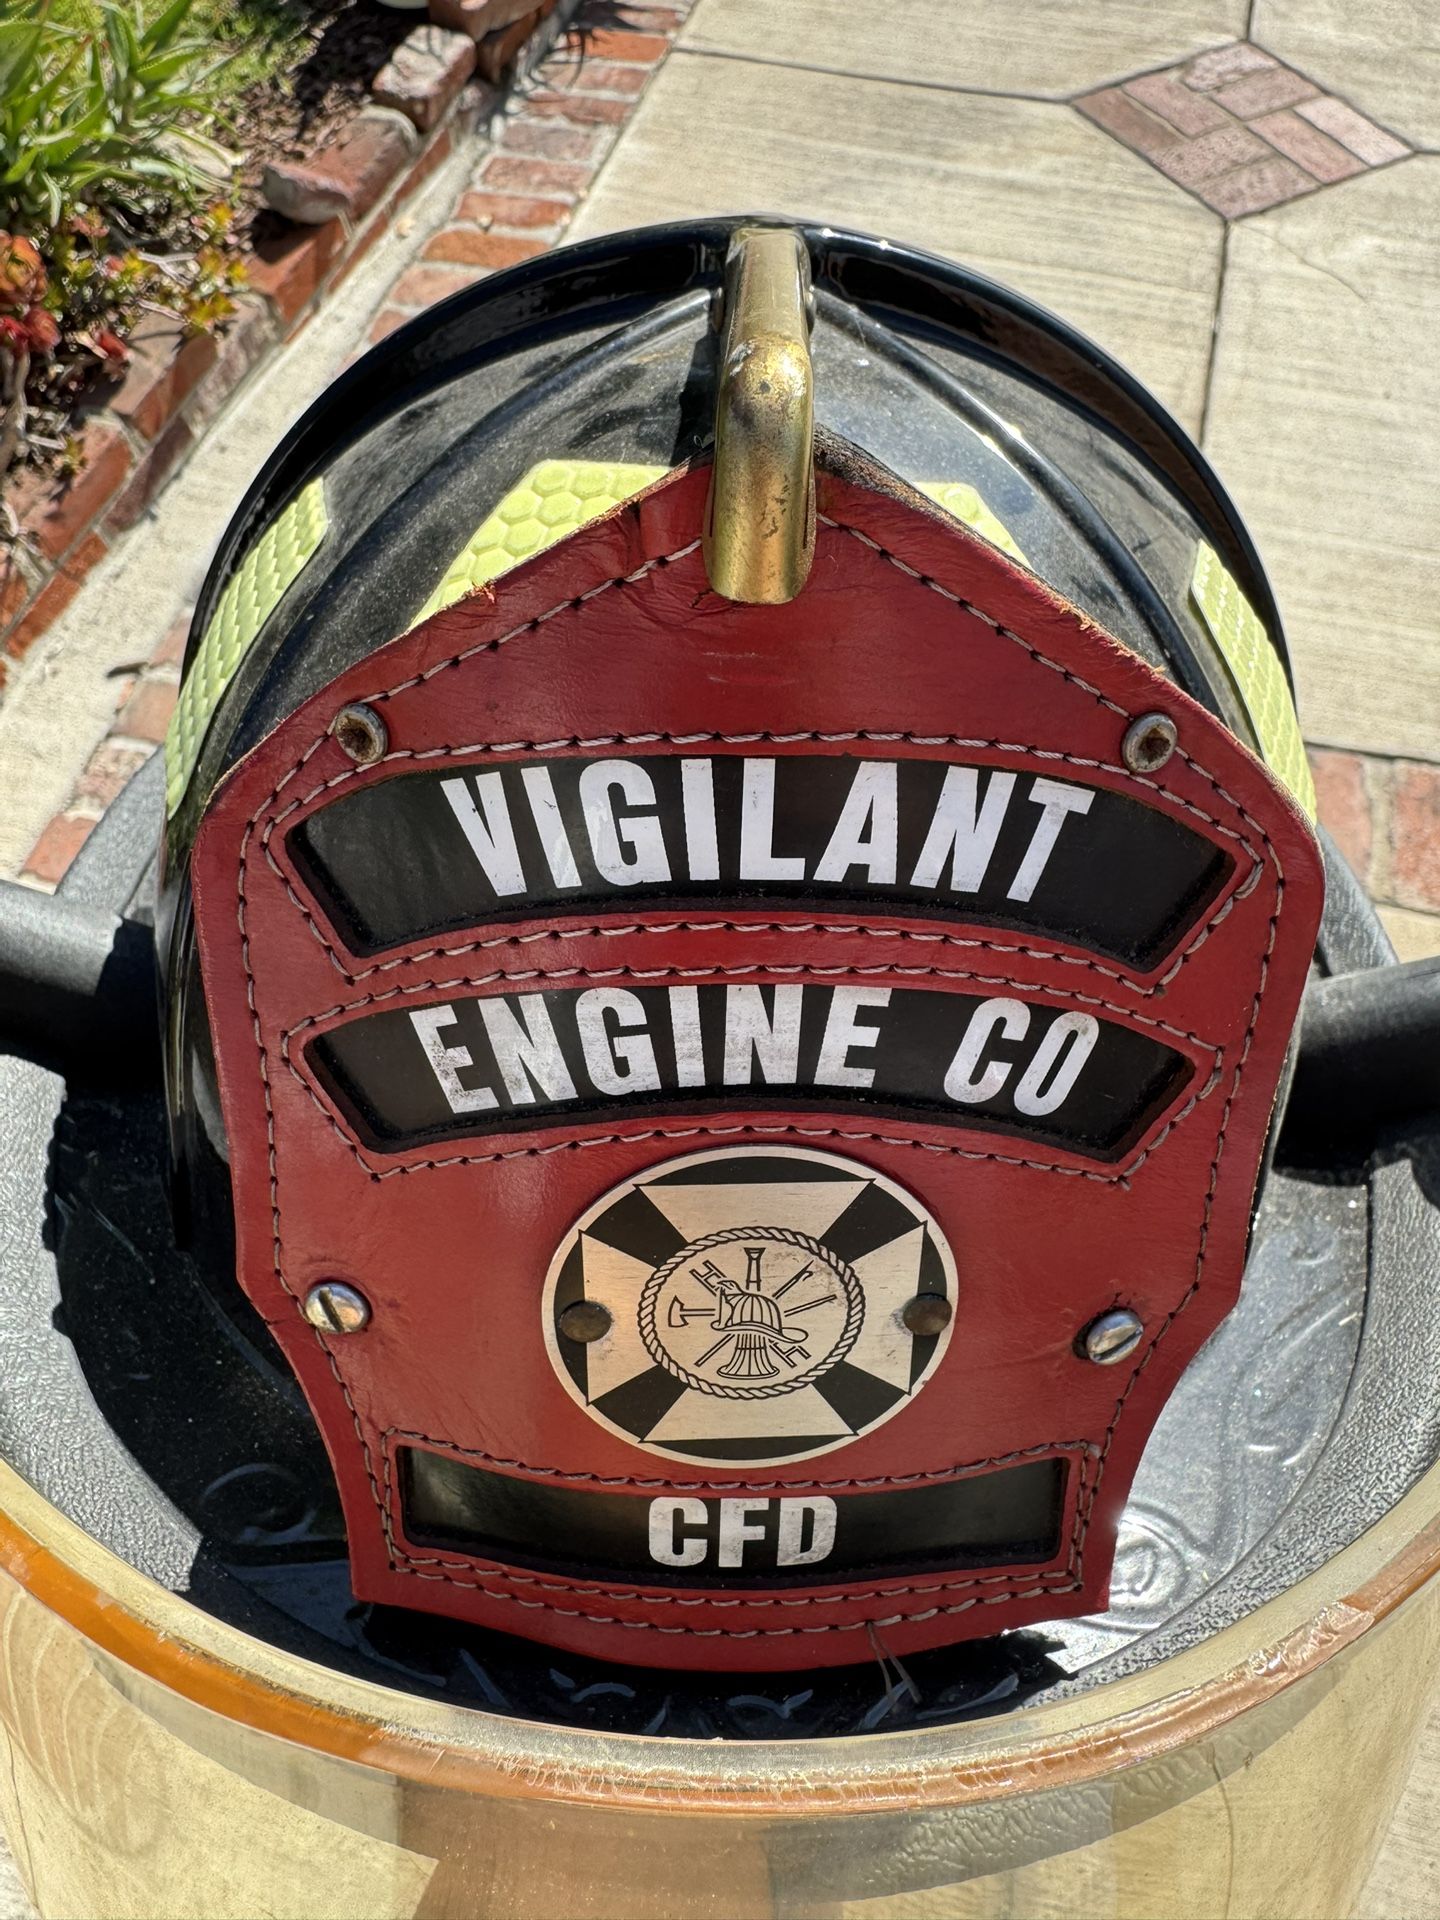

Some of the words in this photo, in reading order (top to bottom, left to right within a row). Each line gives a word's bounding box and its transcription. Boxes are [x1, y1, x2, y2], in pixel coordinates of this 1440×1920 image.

[440, 758, 1096, 902] VIGILANT
[409, 984, 891, 1113] ENGINE
[944, 997, 1098, 1116] CO
[648, 1496, 838, 1568] CFD
